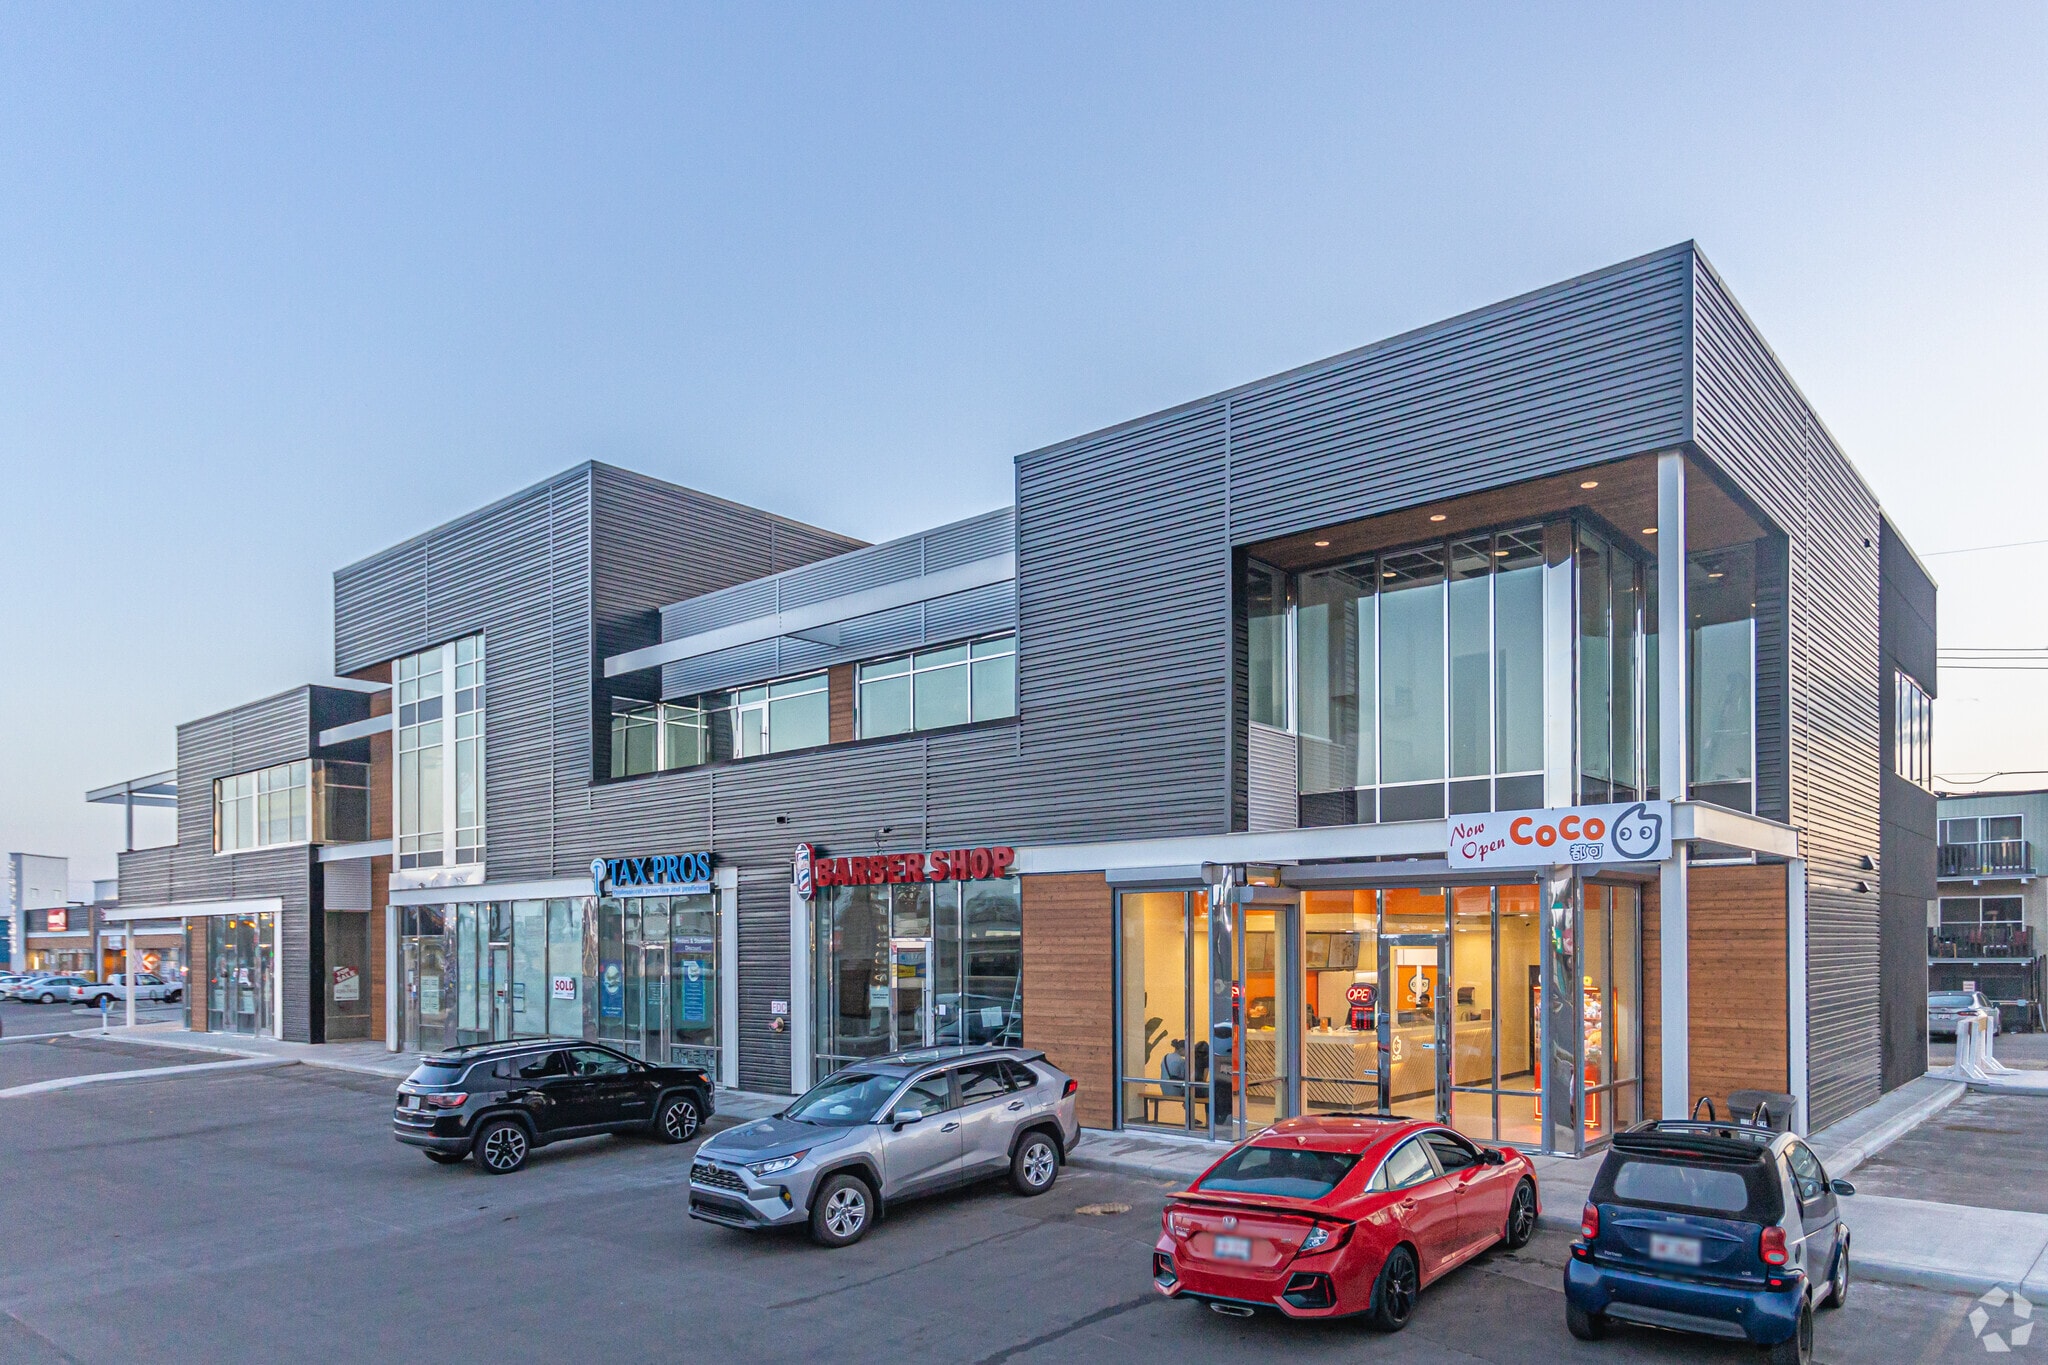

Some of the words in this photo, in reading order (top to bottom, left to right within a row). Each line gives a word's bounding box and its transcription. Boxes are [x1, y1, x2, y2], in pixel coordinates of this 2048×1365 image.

[1450, 822, 1485, 847] Now
[1510, 815, 1606, 847] CoCo
[1461, 838, 1506, 862] Open
[1569, 842, 1604, 861] 都可
[608, 857, 649, 886] TAX
[651, 851, 711, 884] PROS
[816, 853, 926, 887] BARBER
[929, 846, 1015, 882] SHOP
[336, 967, 350, 976] FOR
[336, 970, 355, 982] SALE
[555, 980, 574, 991] SOLD
[1347, 988, 1375, 1001] OPEN
[772, 1002, 787, 1012] FDC
